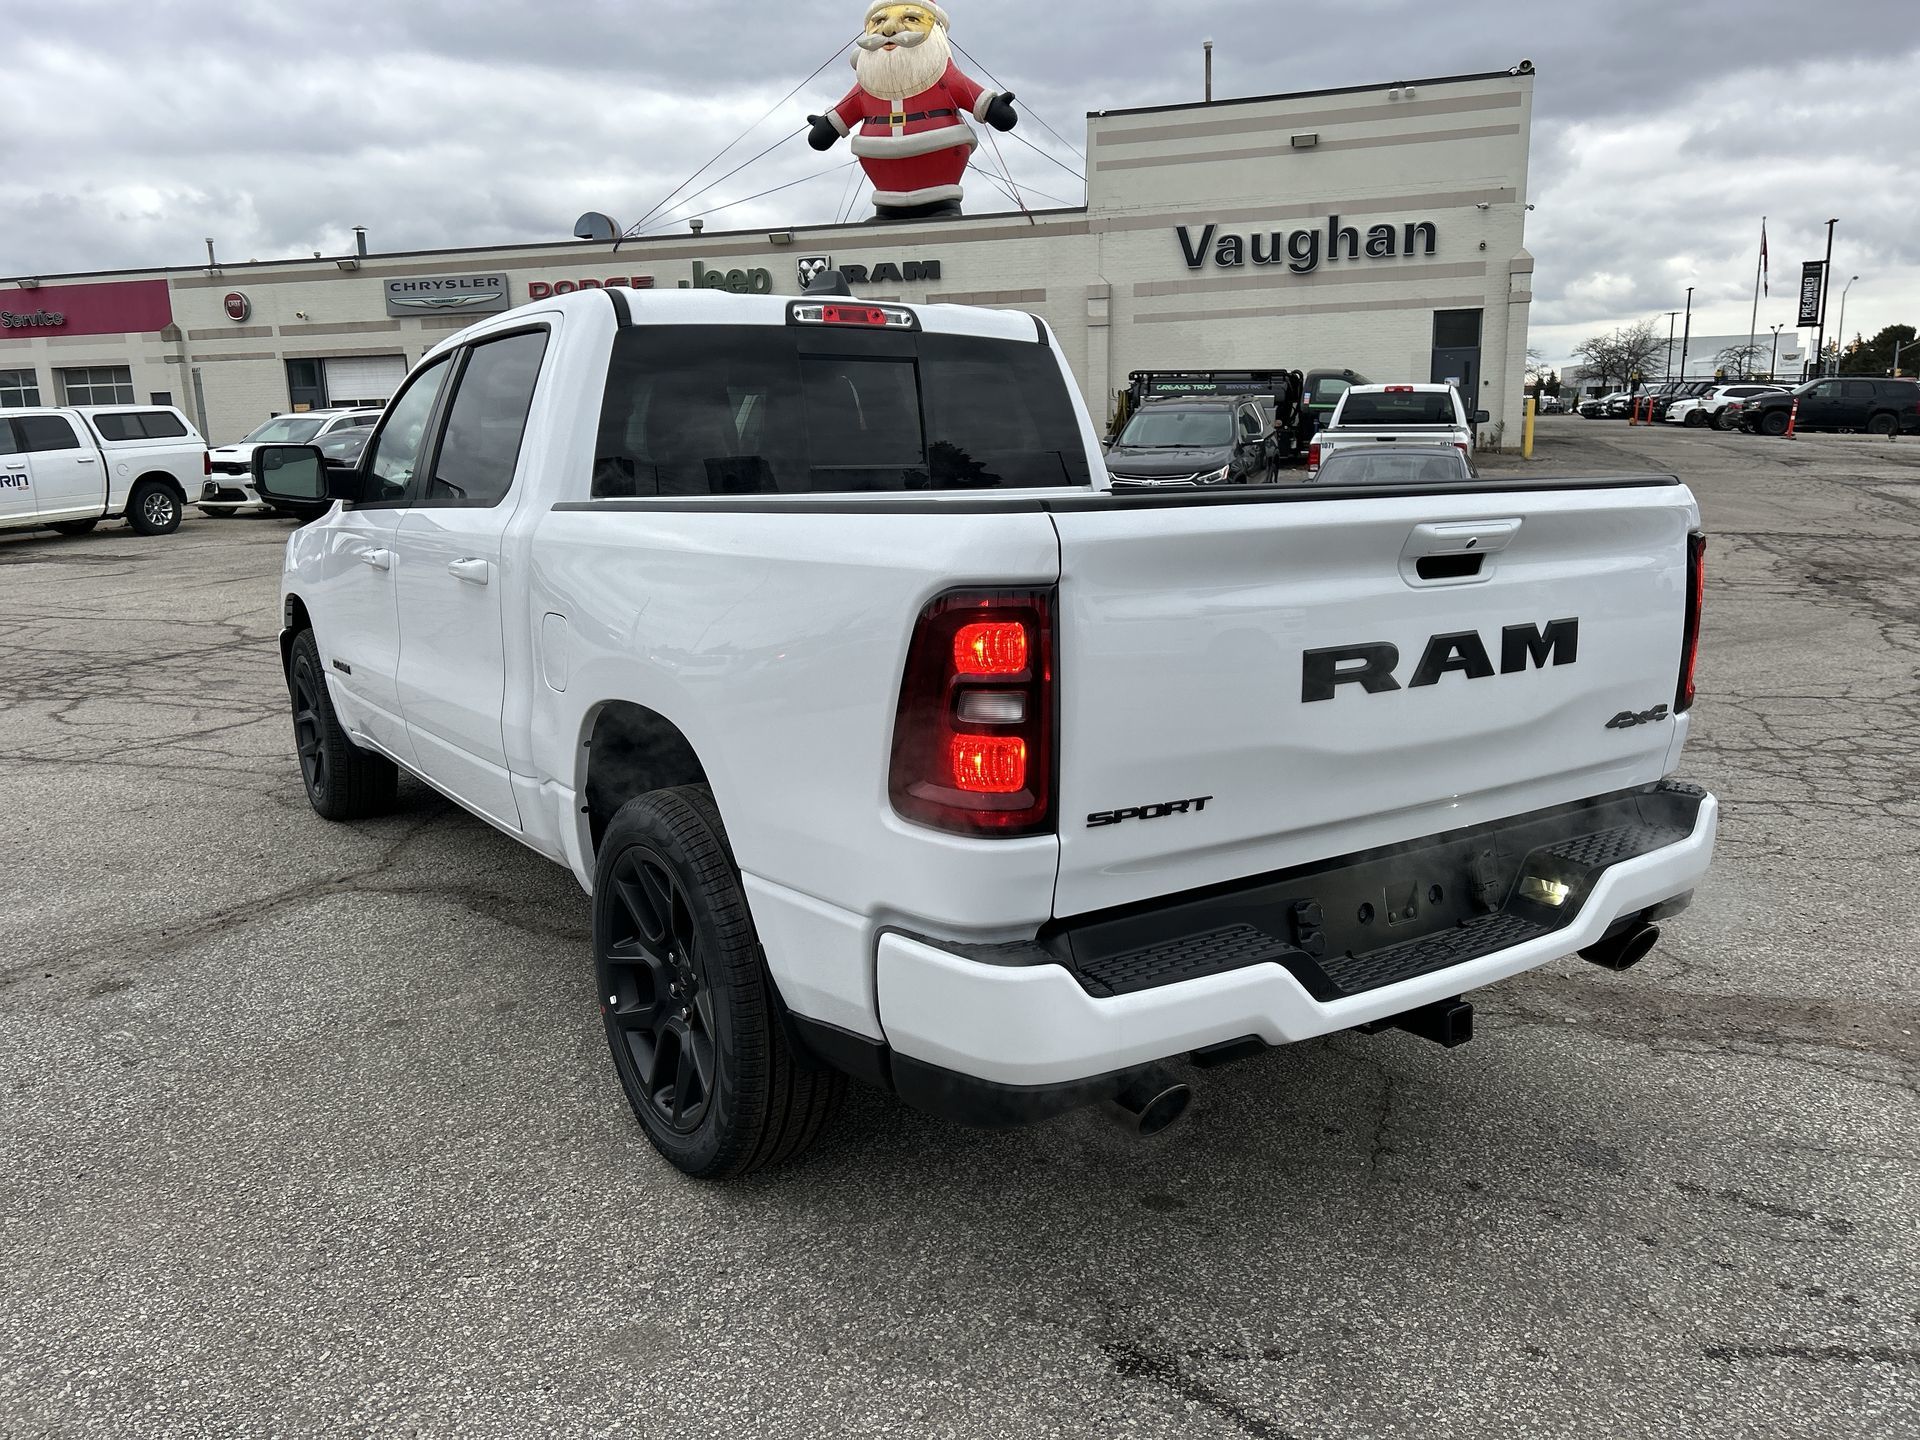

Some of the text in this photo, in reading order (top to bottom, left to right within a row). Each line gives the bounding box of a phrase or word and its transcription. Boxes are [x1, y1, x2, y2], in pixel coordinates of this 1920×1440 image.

[1175, 214, 1438, 274] Vaughan
[390, 277, 500, 292] CHRYSLER
[678, 260, 772, 294] Jeep
[839, 259, 941, 283] RAM
[528, 275, 654, 299] DODGE
[1801, 277, 1814, 318] PRE-OWNED
[1, 309, 63, 328] Service
[1301, 617, 1579, 703] RAM
[1605, 704, 1669, 729] 4x4
[1086, 795, 1214, 828] SPORT
